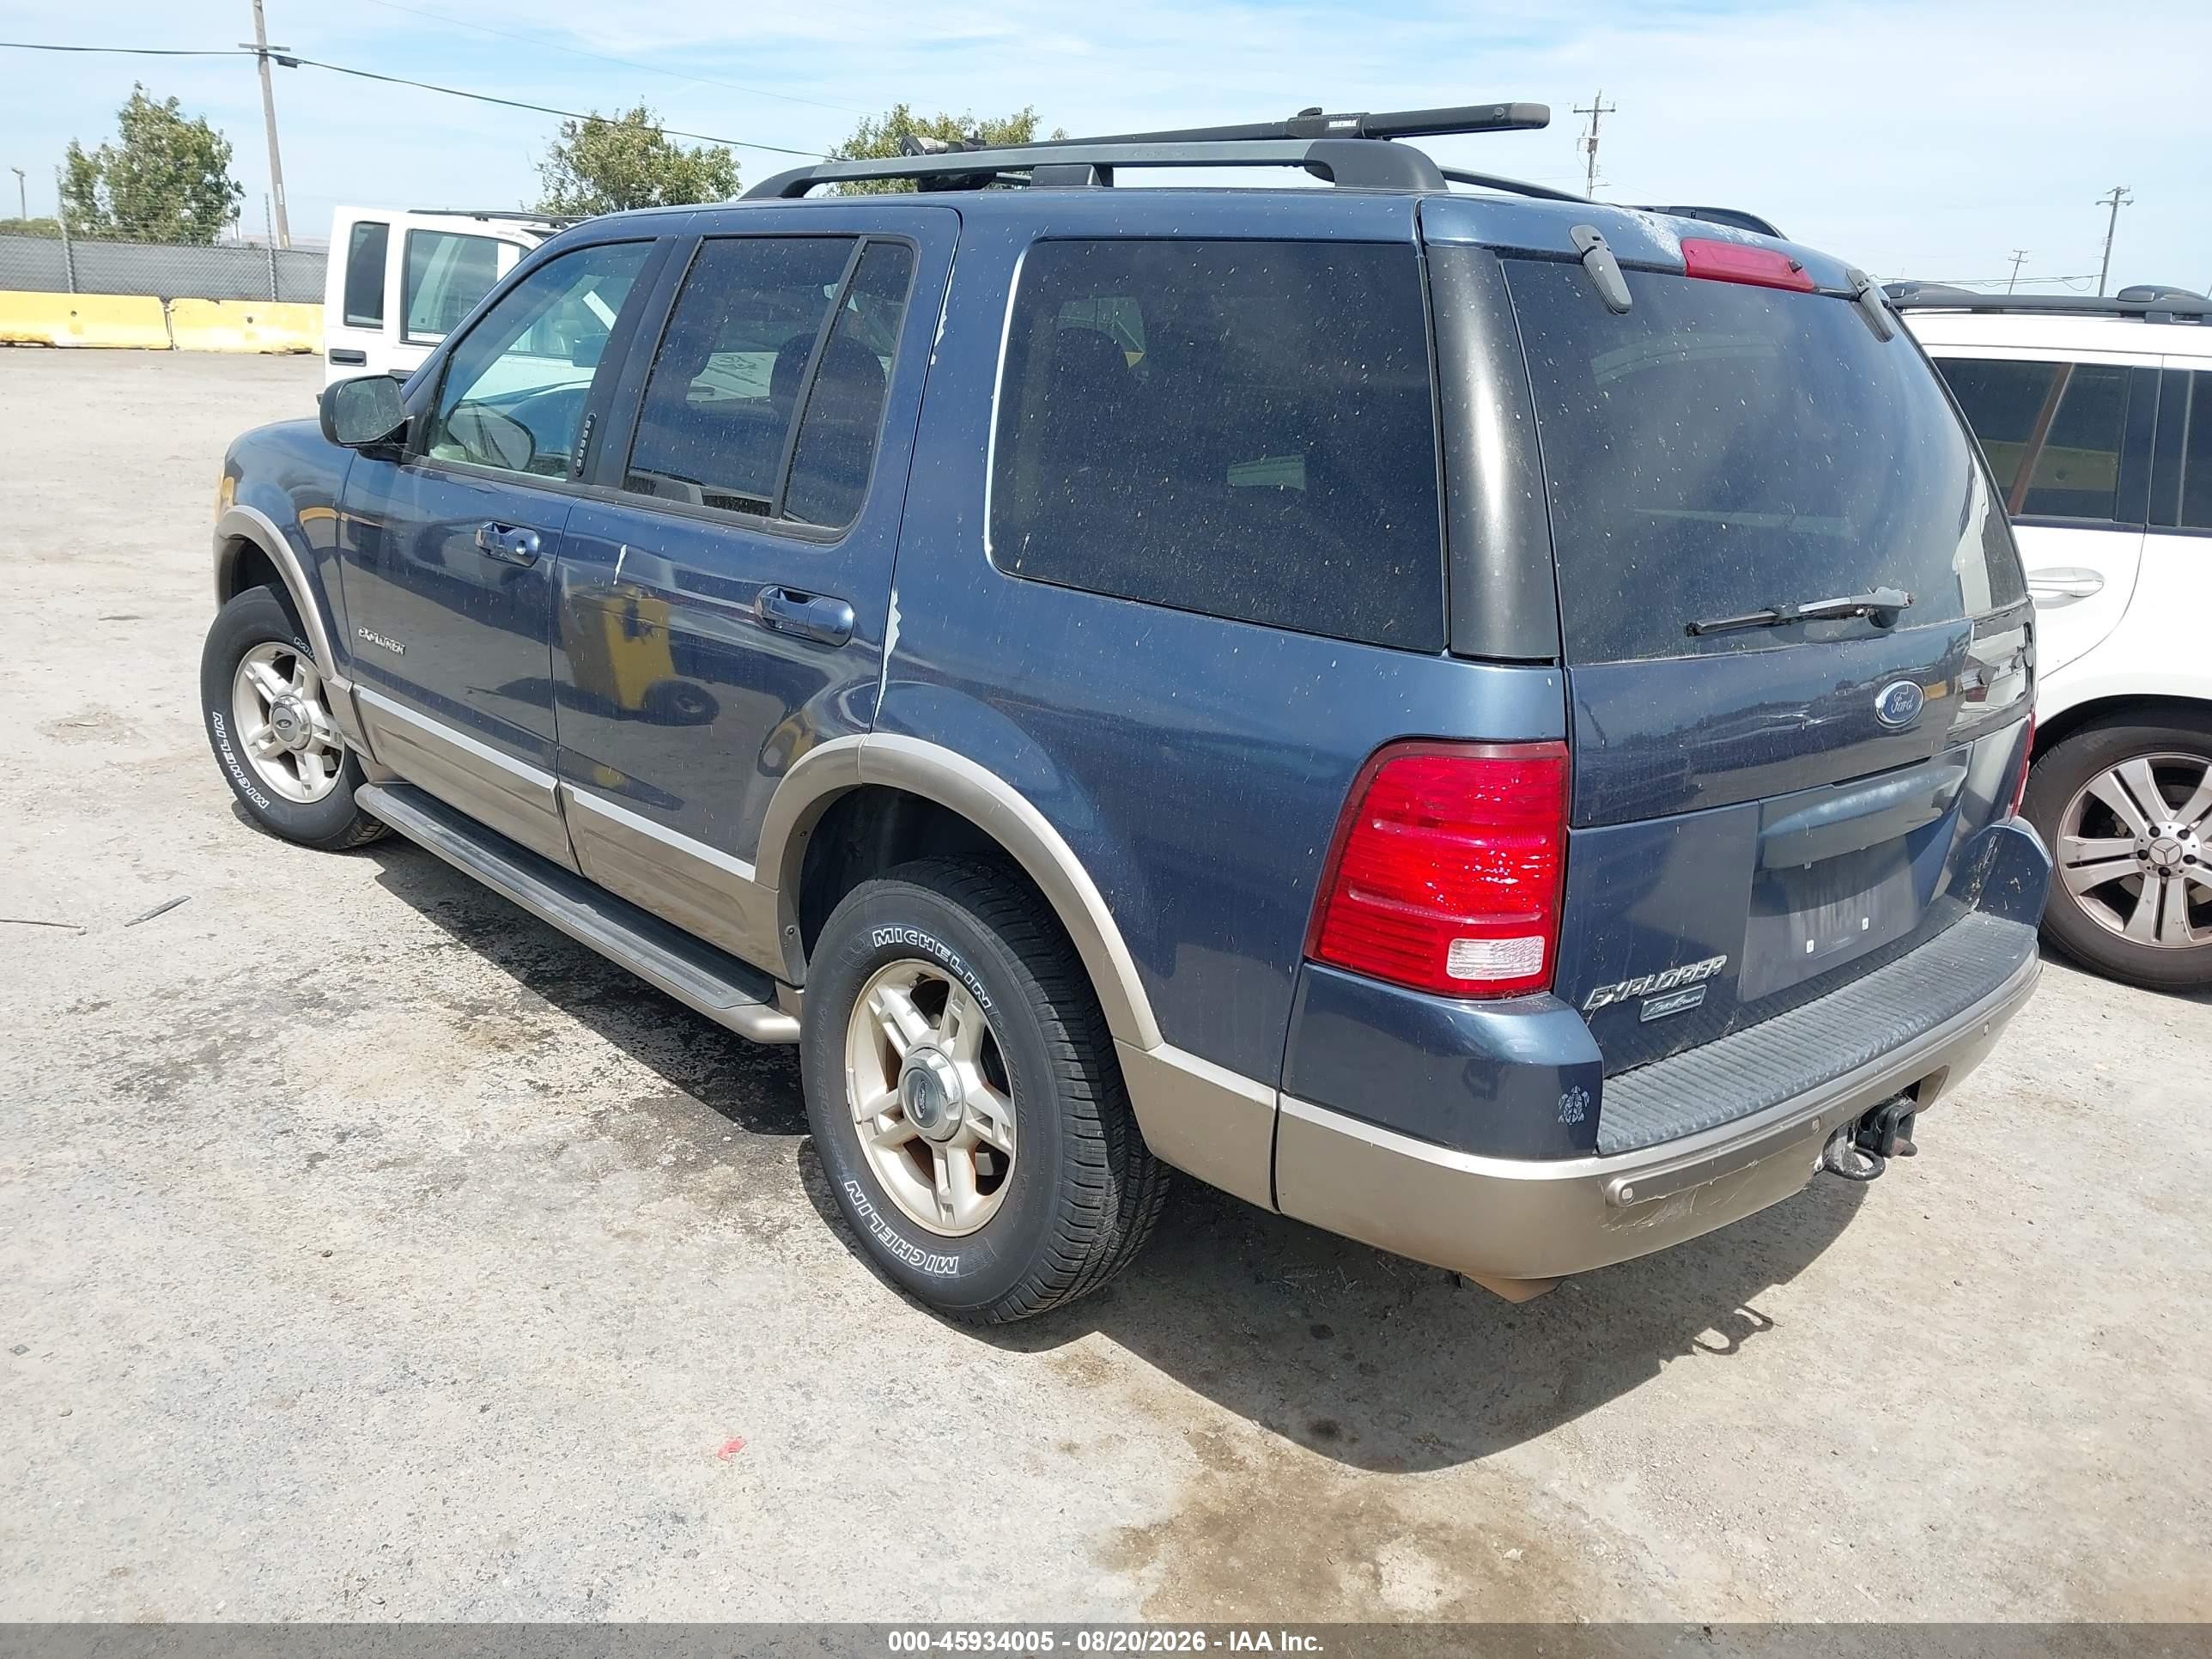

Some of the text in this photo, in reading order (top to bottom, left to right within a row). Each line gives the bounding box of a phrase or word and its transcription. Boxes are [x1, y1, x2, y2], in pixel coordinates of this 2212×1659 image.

[1891, 685, 1915, 714] Ford
[213, 711, 270, 810] MICHELIN
[872, 927, 992, 1010] MICHELIN
[1583, 955, 1728, 1011] EXPLORER
[844, 1180, 959, 1274] MICHELIN
